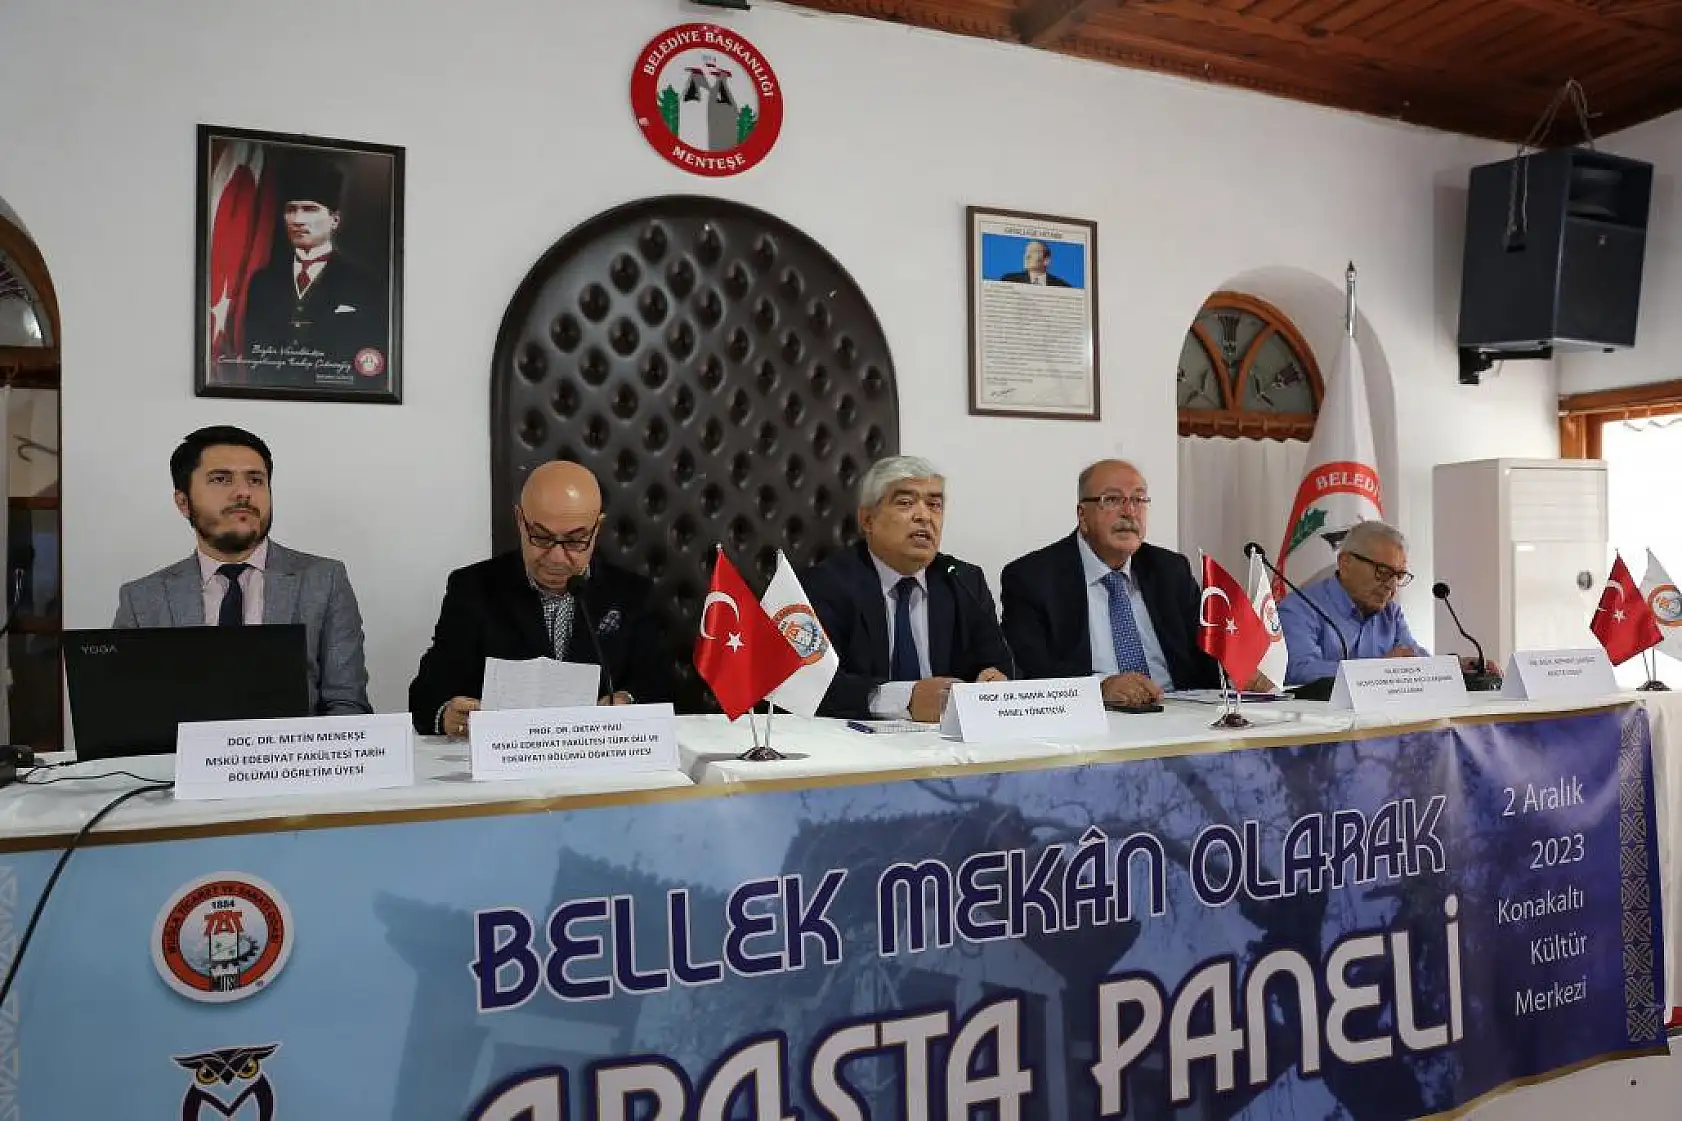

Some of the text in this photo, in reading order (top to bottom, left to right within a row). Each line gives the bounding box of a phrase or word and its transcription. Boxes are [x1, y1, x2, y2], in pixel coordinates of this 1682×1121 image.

[643, 30, 773, 98] BELEDİYE BAŞKANLIĞI
[672, 145, 747, 171] MENTEŞE
[1315, 471, 1378, 496] BELED
[81, 644, 118, 655] YOGA
[205, 746, 385, 767] MSKÜ EDEBİYAT FAKÜLTESİ TARİH
[228, 736, 254, 748] DOÇ.
[279, 732, 314, 744] METİN
[317, 730, 366, 743] MENEKŞE
[282, 766, 333, 779] ÖĞRETİM
[1502, 776, 1584, 817] 2 Aralık
[1529, 834, 1586, 870] 2023
[471, 795, 1448, 1013] BELLEK MEKÂN OLARAK
[1497, 886, 1584, 924] Konakaltı
[1530, 931, 1588, 966] Kültür
[1091, 894, 1464, 1118] PANELİ
[1515, 975, 1588, 1016] Merkezi
